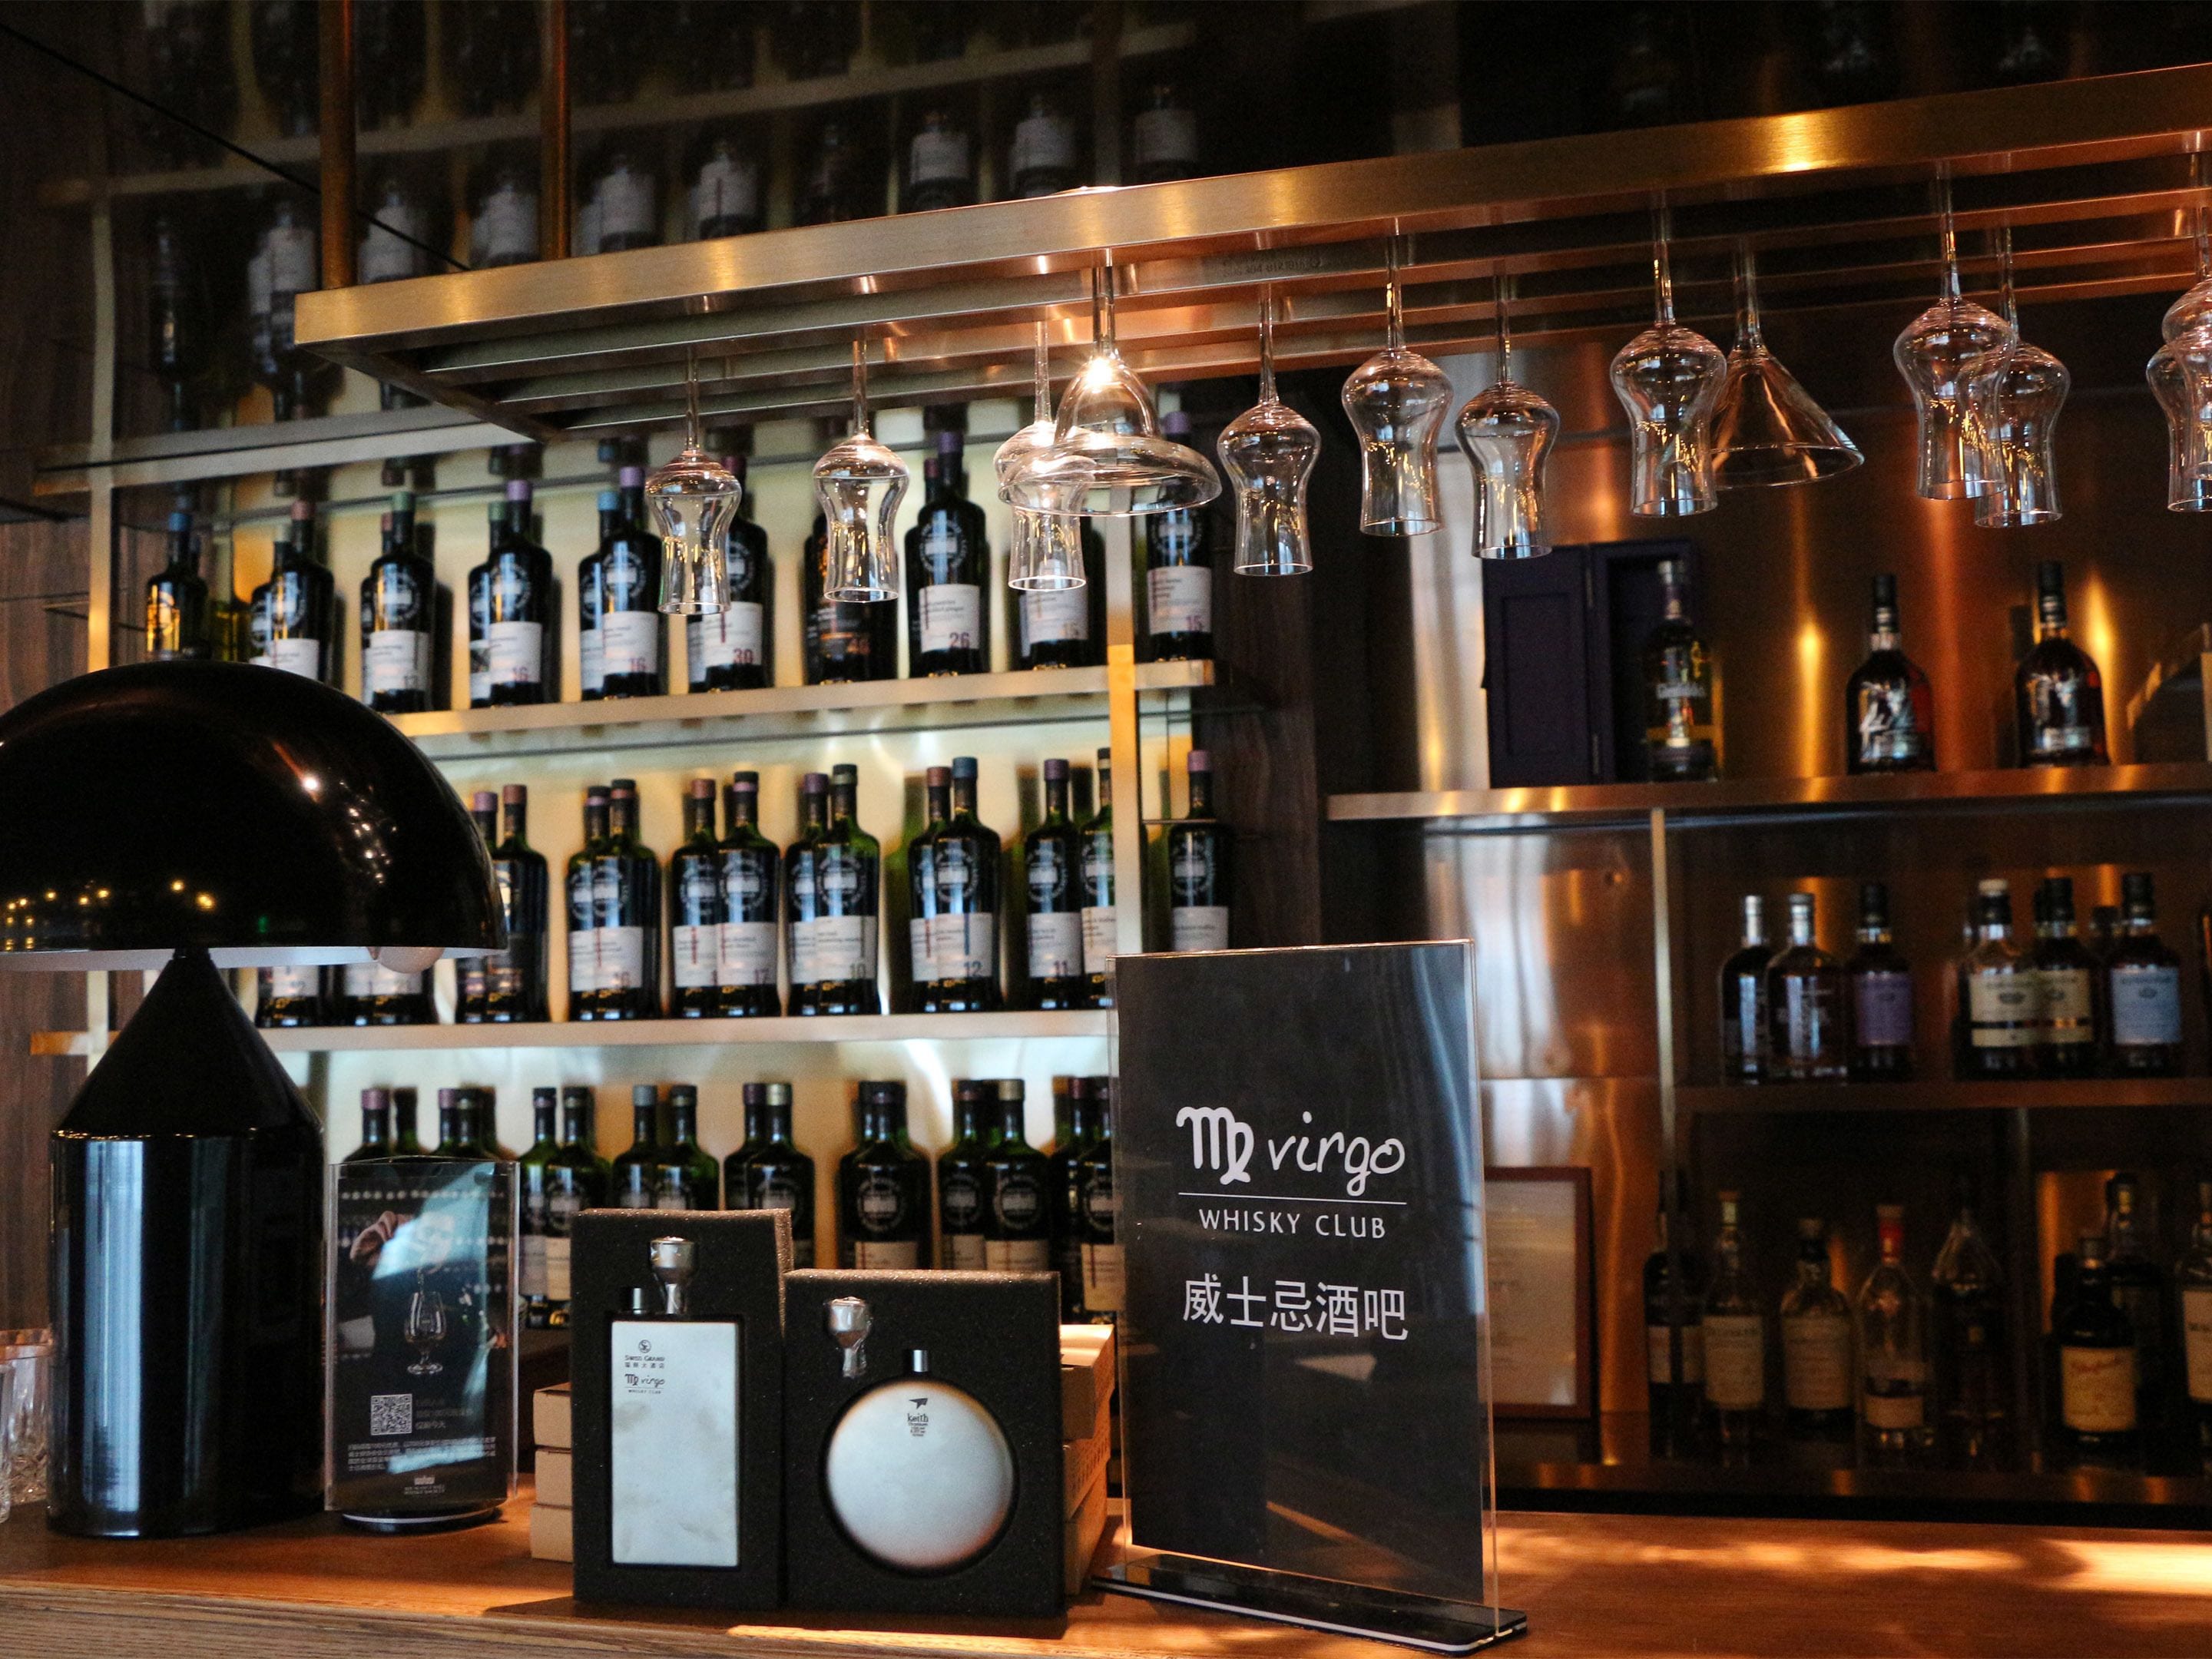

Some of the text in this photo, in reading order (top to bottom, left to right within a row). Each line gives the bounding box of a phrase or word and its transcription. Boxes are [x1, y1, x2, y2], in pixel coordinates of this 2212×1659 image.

[949, 632, 971, 649] 26
[733, 648, 754, 665] 30
[964, 959, 983, 977] 12
[1267, 1111, 1406, 1197] virgo
[1198, 1208, 1386, 1239] WHISKY CLUB
[1182, 1273, 1409, 1341] 威士忌酒吧
[641, 1374, 666, 1388] virgo
[907, 1412, 929, 1422] keith
